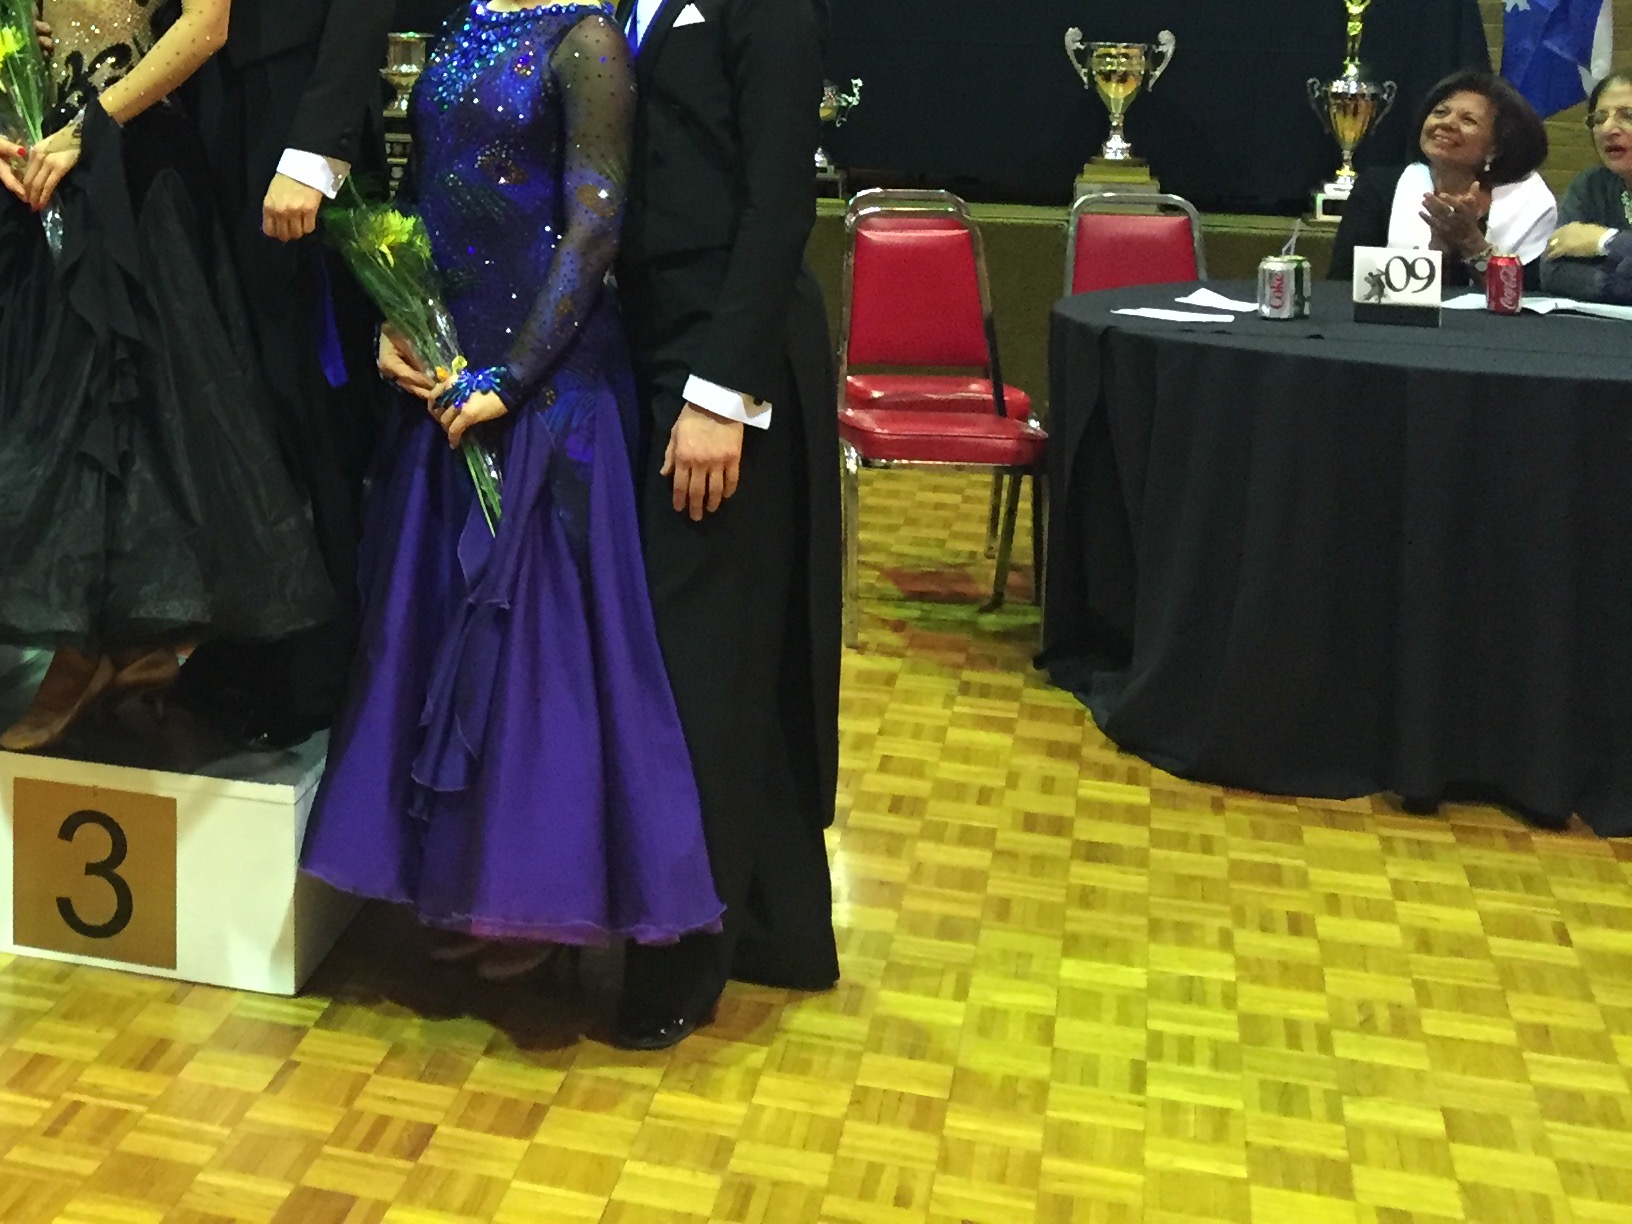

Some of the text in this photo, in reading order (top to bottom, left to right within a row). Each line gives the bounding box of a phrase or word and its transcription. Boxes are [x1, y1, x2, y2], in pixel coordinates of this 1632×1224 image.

[1269, 273, 1284, 309] Coke
[1384, 255, 1436, 294] 09
[55, 809, 134, 940] 3
